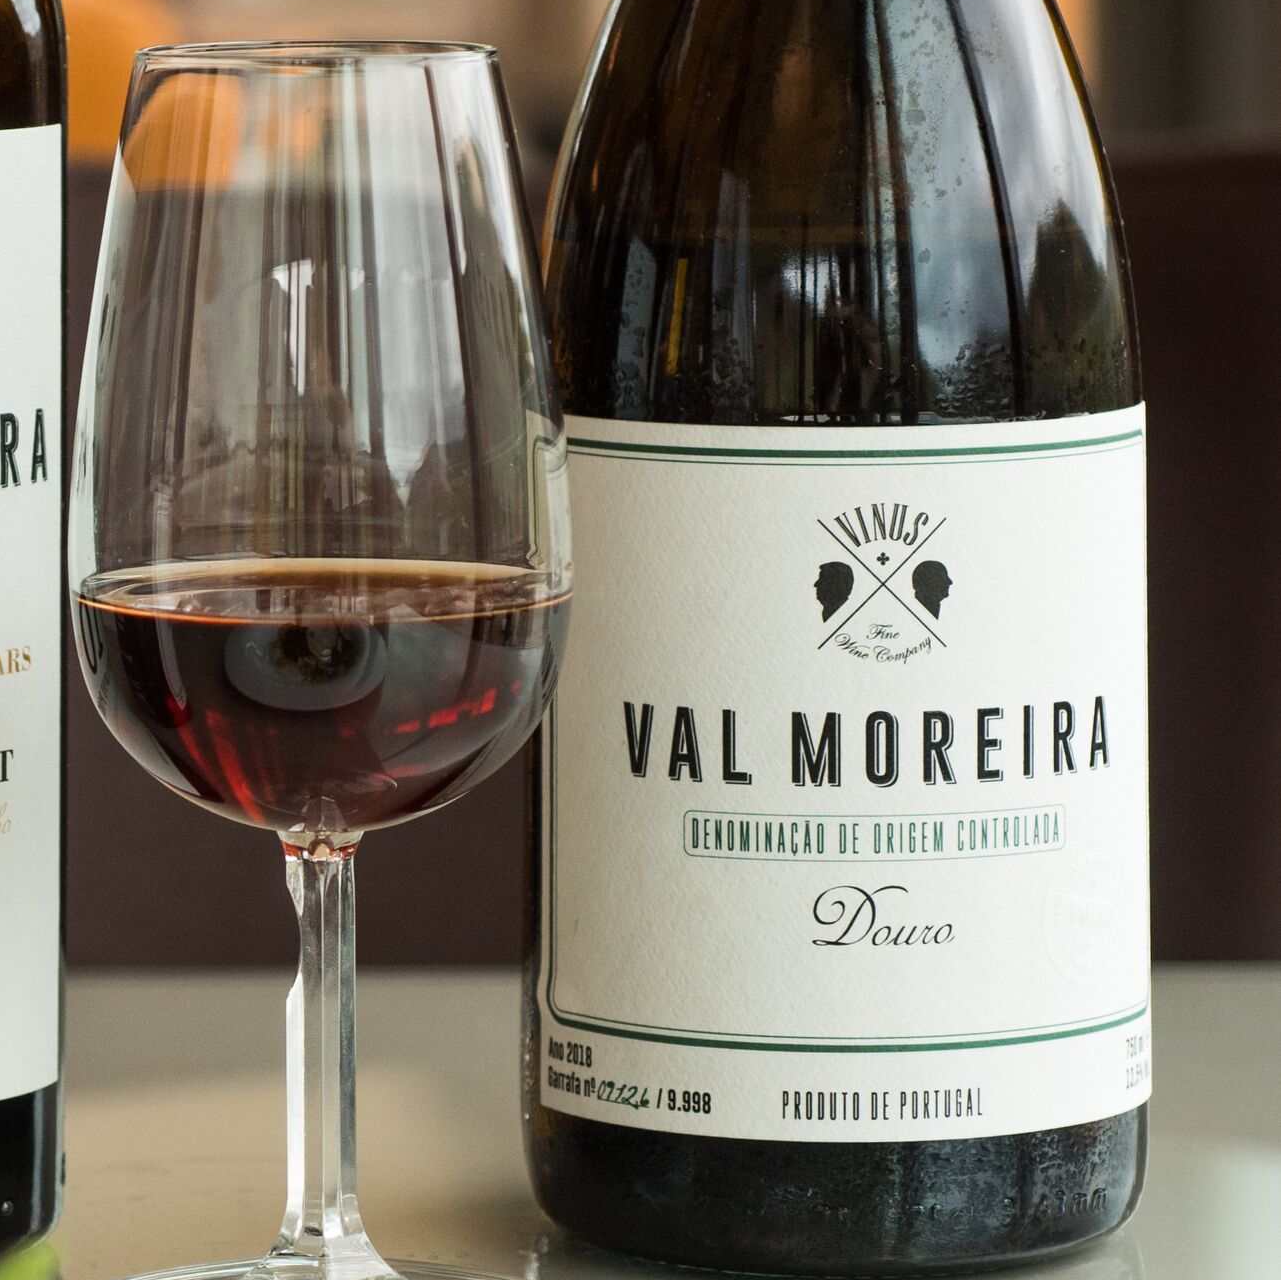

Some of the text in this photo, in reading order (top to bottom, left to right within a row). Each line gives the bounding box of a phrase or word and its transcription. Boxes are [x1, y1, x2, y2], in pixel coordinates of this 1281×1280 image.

[833, 503, 930, 548] VINUS
[834, 632, 932, 665] Wine Company
[866, 623, 900, 640] Fine
[623, 695, 1111, 789] VAL MOREIRA
[691, 812, 1060, 858] DENOMINAÇÃO DE ORIGEM CONTROLADA
[812, 884, 956, 948] Douro
[549, 1036, 593, 1068] Ano 2018
[548, 1065, 581, 1096] Garrafa
[668, 1089, 712, 1115] 9.998
[781, 1087, 984, 1122] PRODUTO DE PORTUGAL
